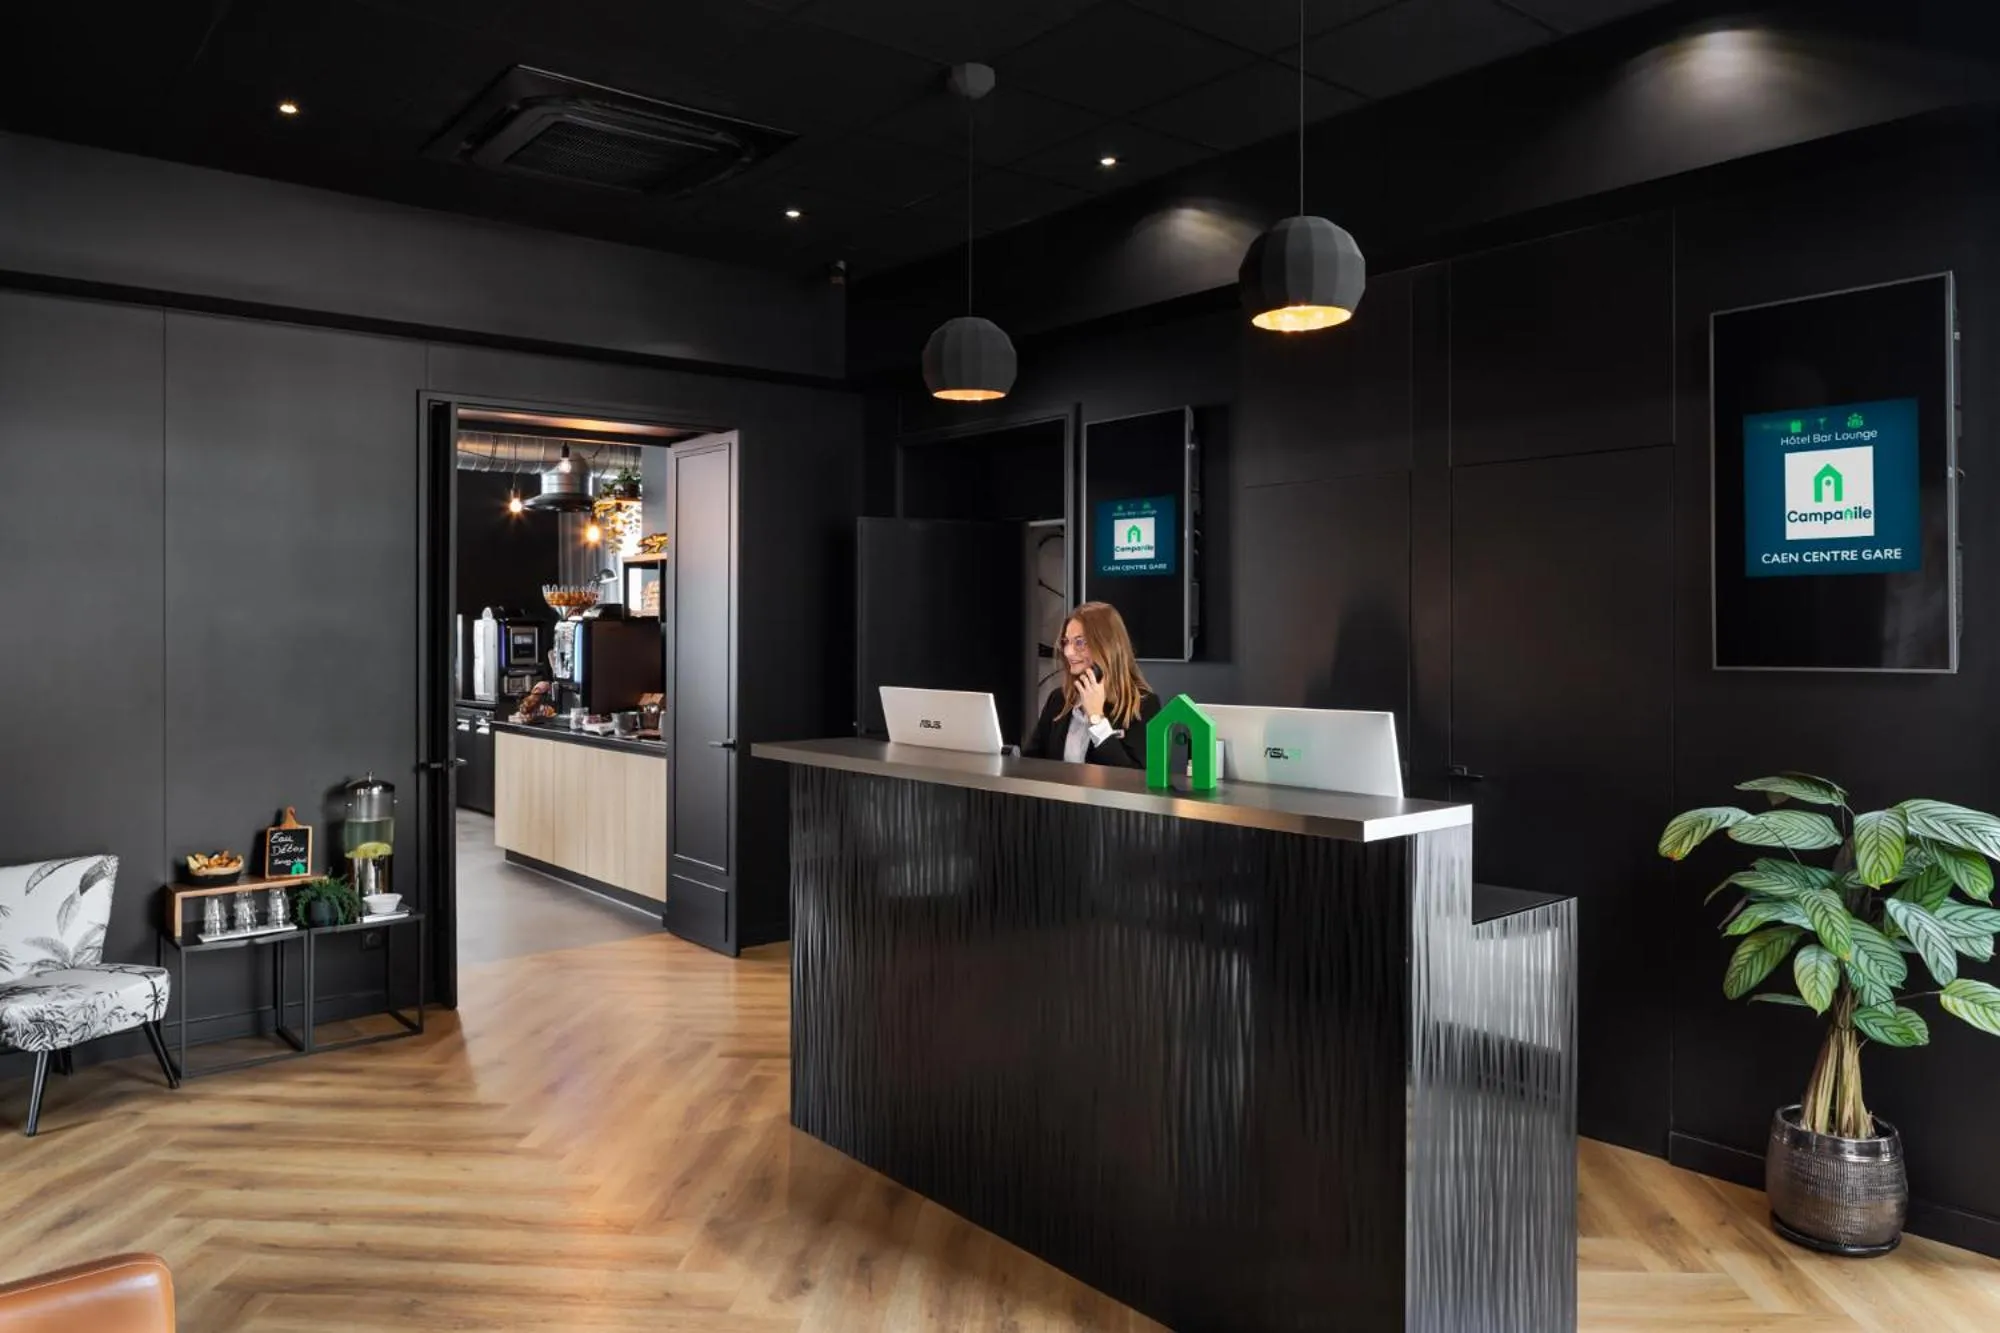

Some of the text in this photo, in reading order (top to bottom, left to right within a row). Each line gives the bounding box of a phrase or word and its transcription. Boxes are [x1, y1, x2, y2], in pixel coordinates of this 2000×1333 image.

[1780, 429, 1878, 446] Hôtel Bar Lounge
[1787, 506, 1873, 525] Campanile
[1761, 548, 1903, 564] CAEN CENTRE GARE
[919, 719, 942, 730] ASUS
